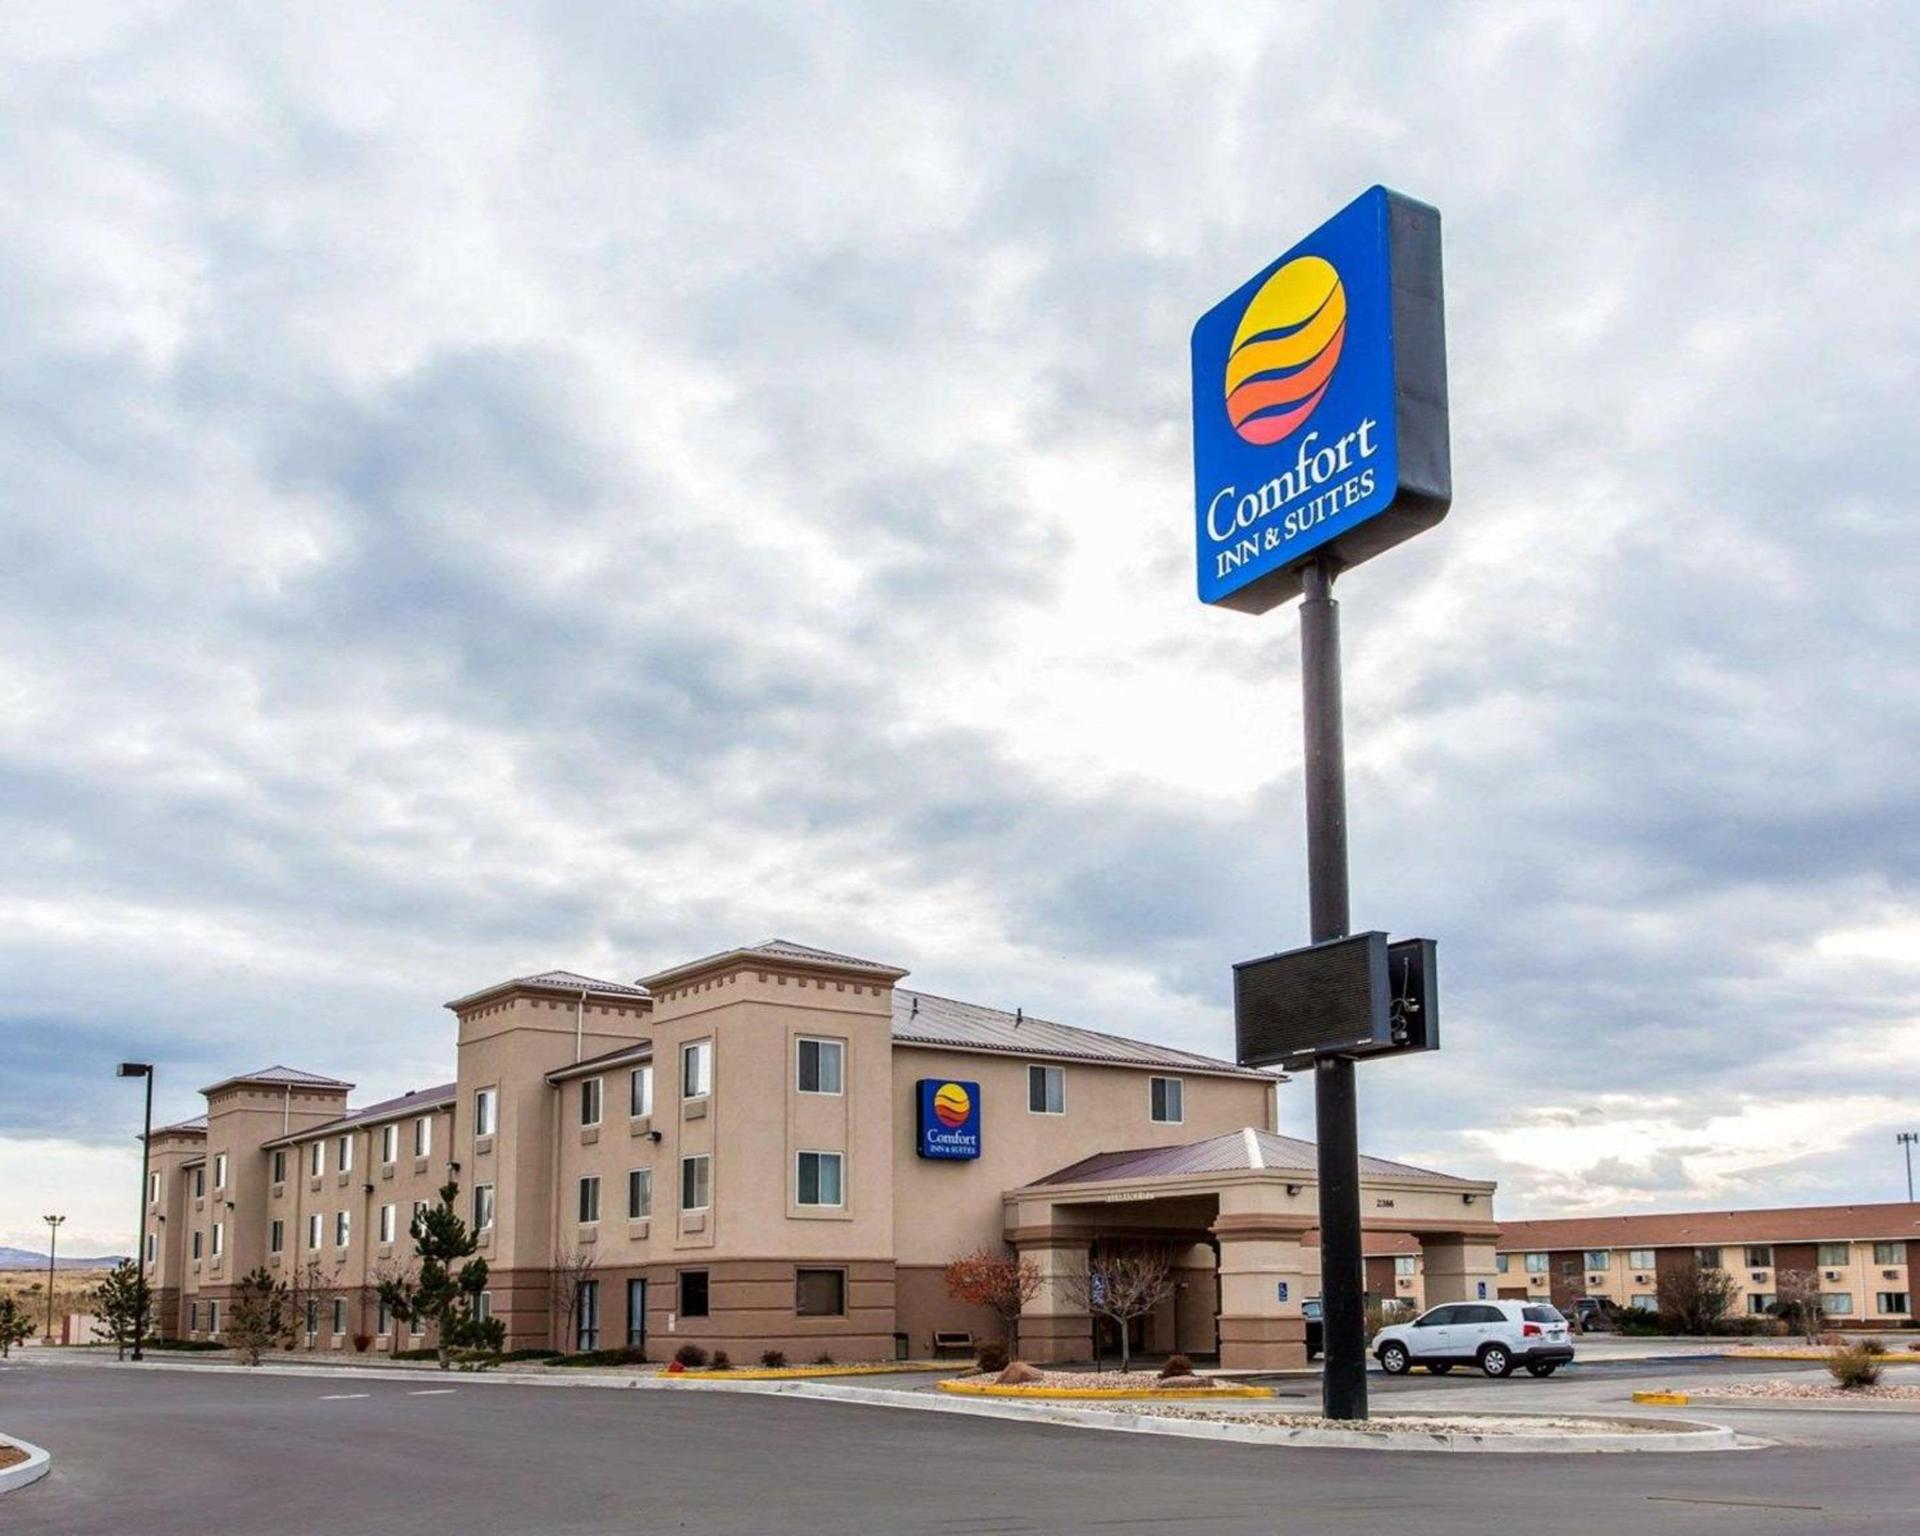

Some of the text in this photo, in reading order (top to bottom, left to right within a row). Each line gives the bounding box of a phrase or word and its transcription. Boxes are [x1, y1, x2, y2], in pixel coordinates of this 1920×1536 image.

[1207, 417, 1378, 541] Comfort
[1216, 469, 1375, 578] INN & SUITES
[927, 1128, 976, 1145] Comfort
